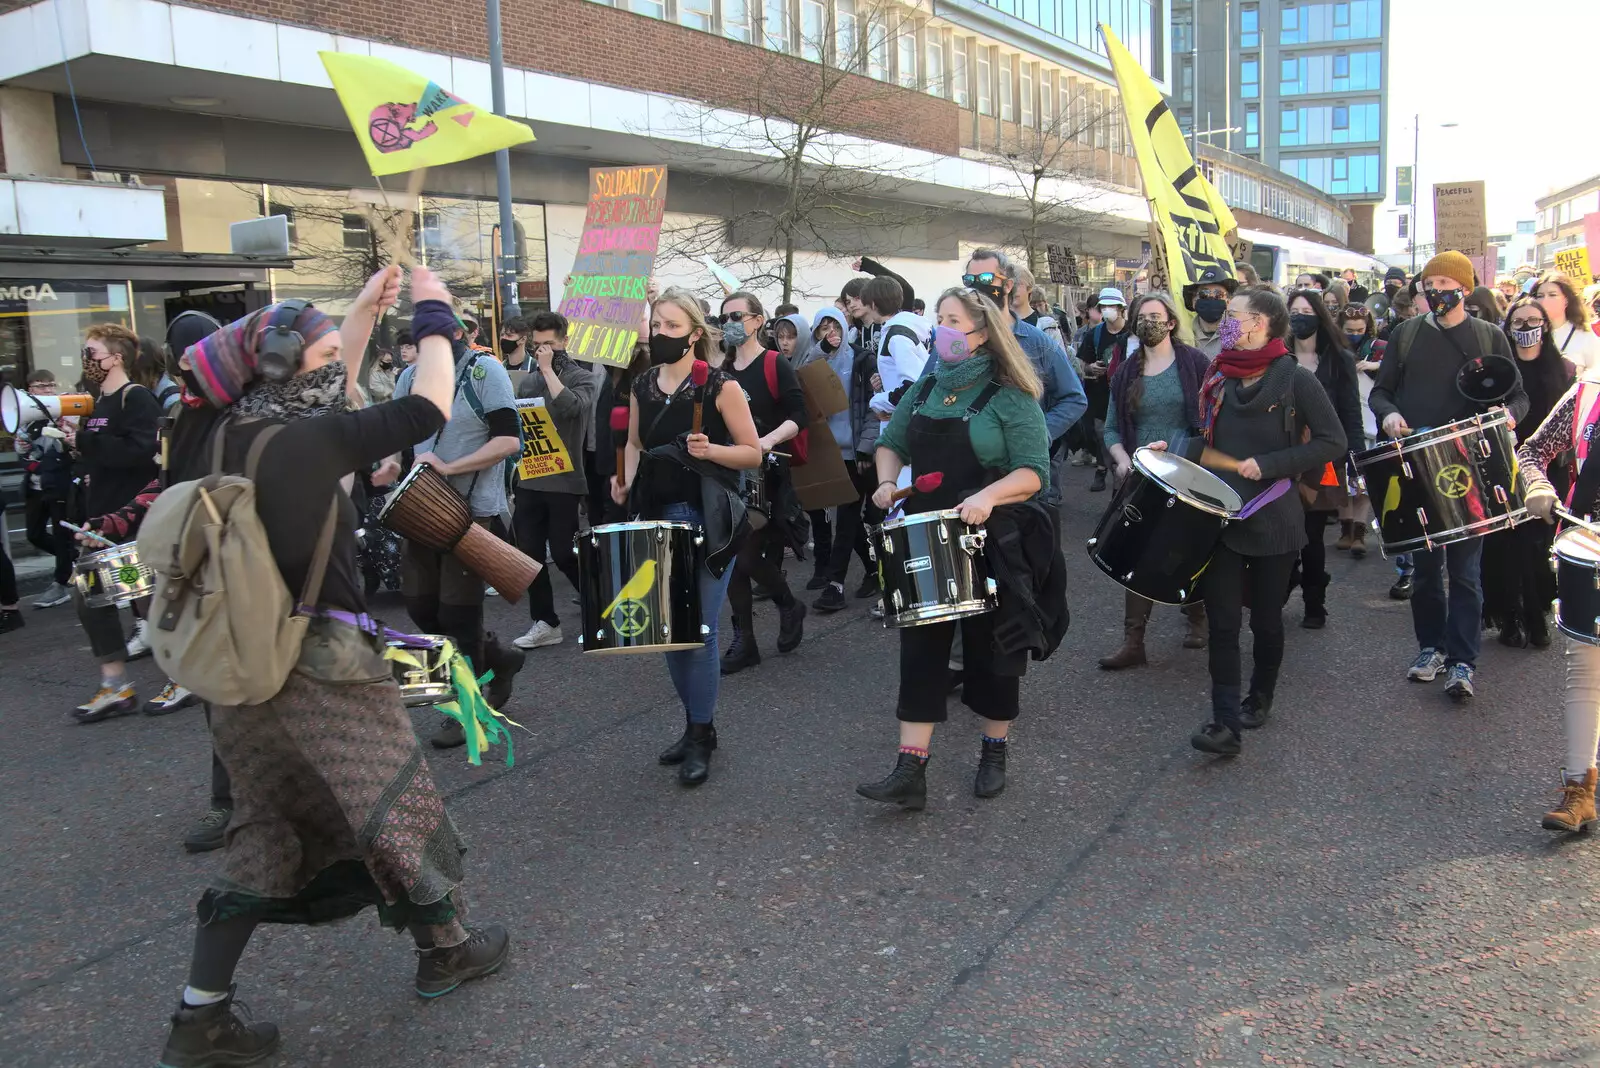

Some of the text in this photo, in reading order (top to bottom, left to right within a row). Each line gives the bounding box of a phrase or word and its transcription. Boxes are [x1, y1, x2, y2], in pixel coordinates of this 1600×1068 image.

[592, 167, 664, 200] SOLIDARITY
[1436, 187, 1472, 197] PEACEFUL
[1557, 251, 1583, 263] KILL
[1557, 260, 1581, 271] THE
[1567, 269, 1586, 278] ILL
[563, 274, 648, 300] PROTESTERS
[578, 324, 600, 355] OF
[593, 326, 639, 363] COLOUR
[1513, 328, 1541, 347] CRIME
[522, 425, 548, 442] HE
[522, 439, 561, 458] BILL
[533, 454, 553, 463] MORE
[525, 461, 548, 470] POLICE
[526, 466, 555, 476] POWERS
